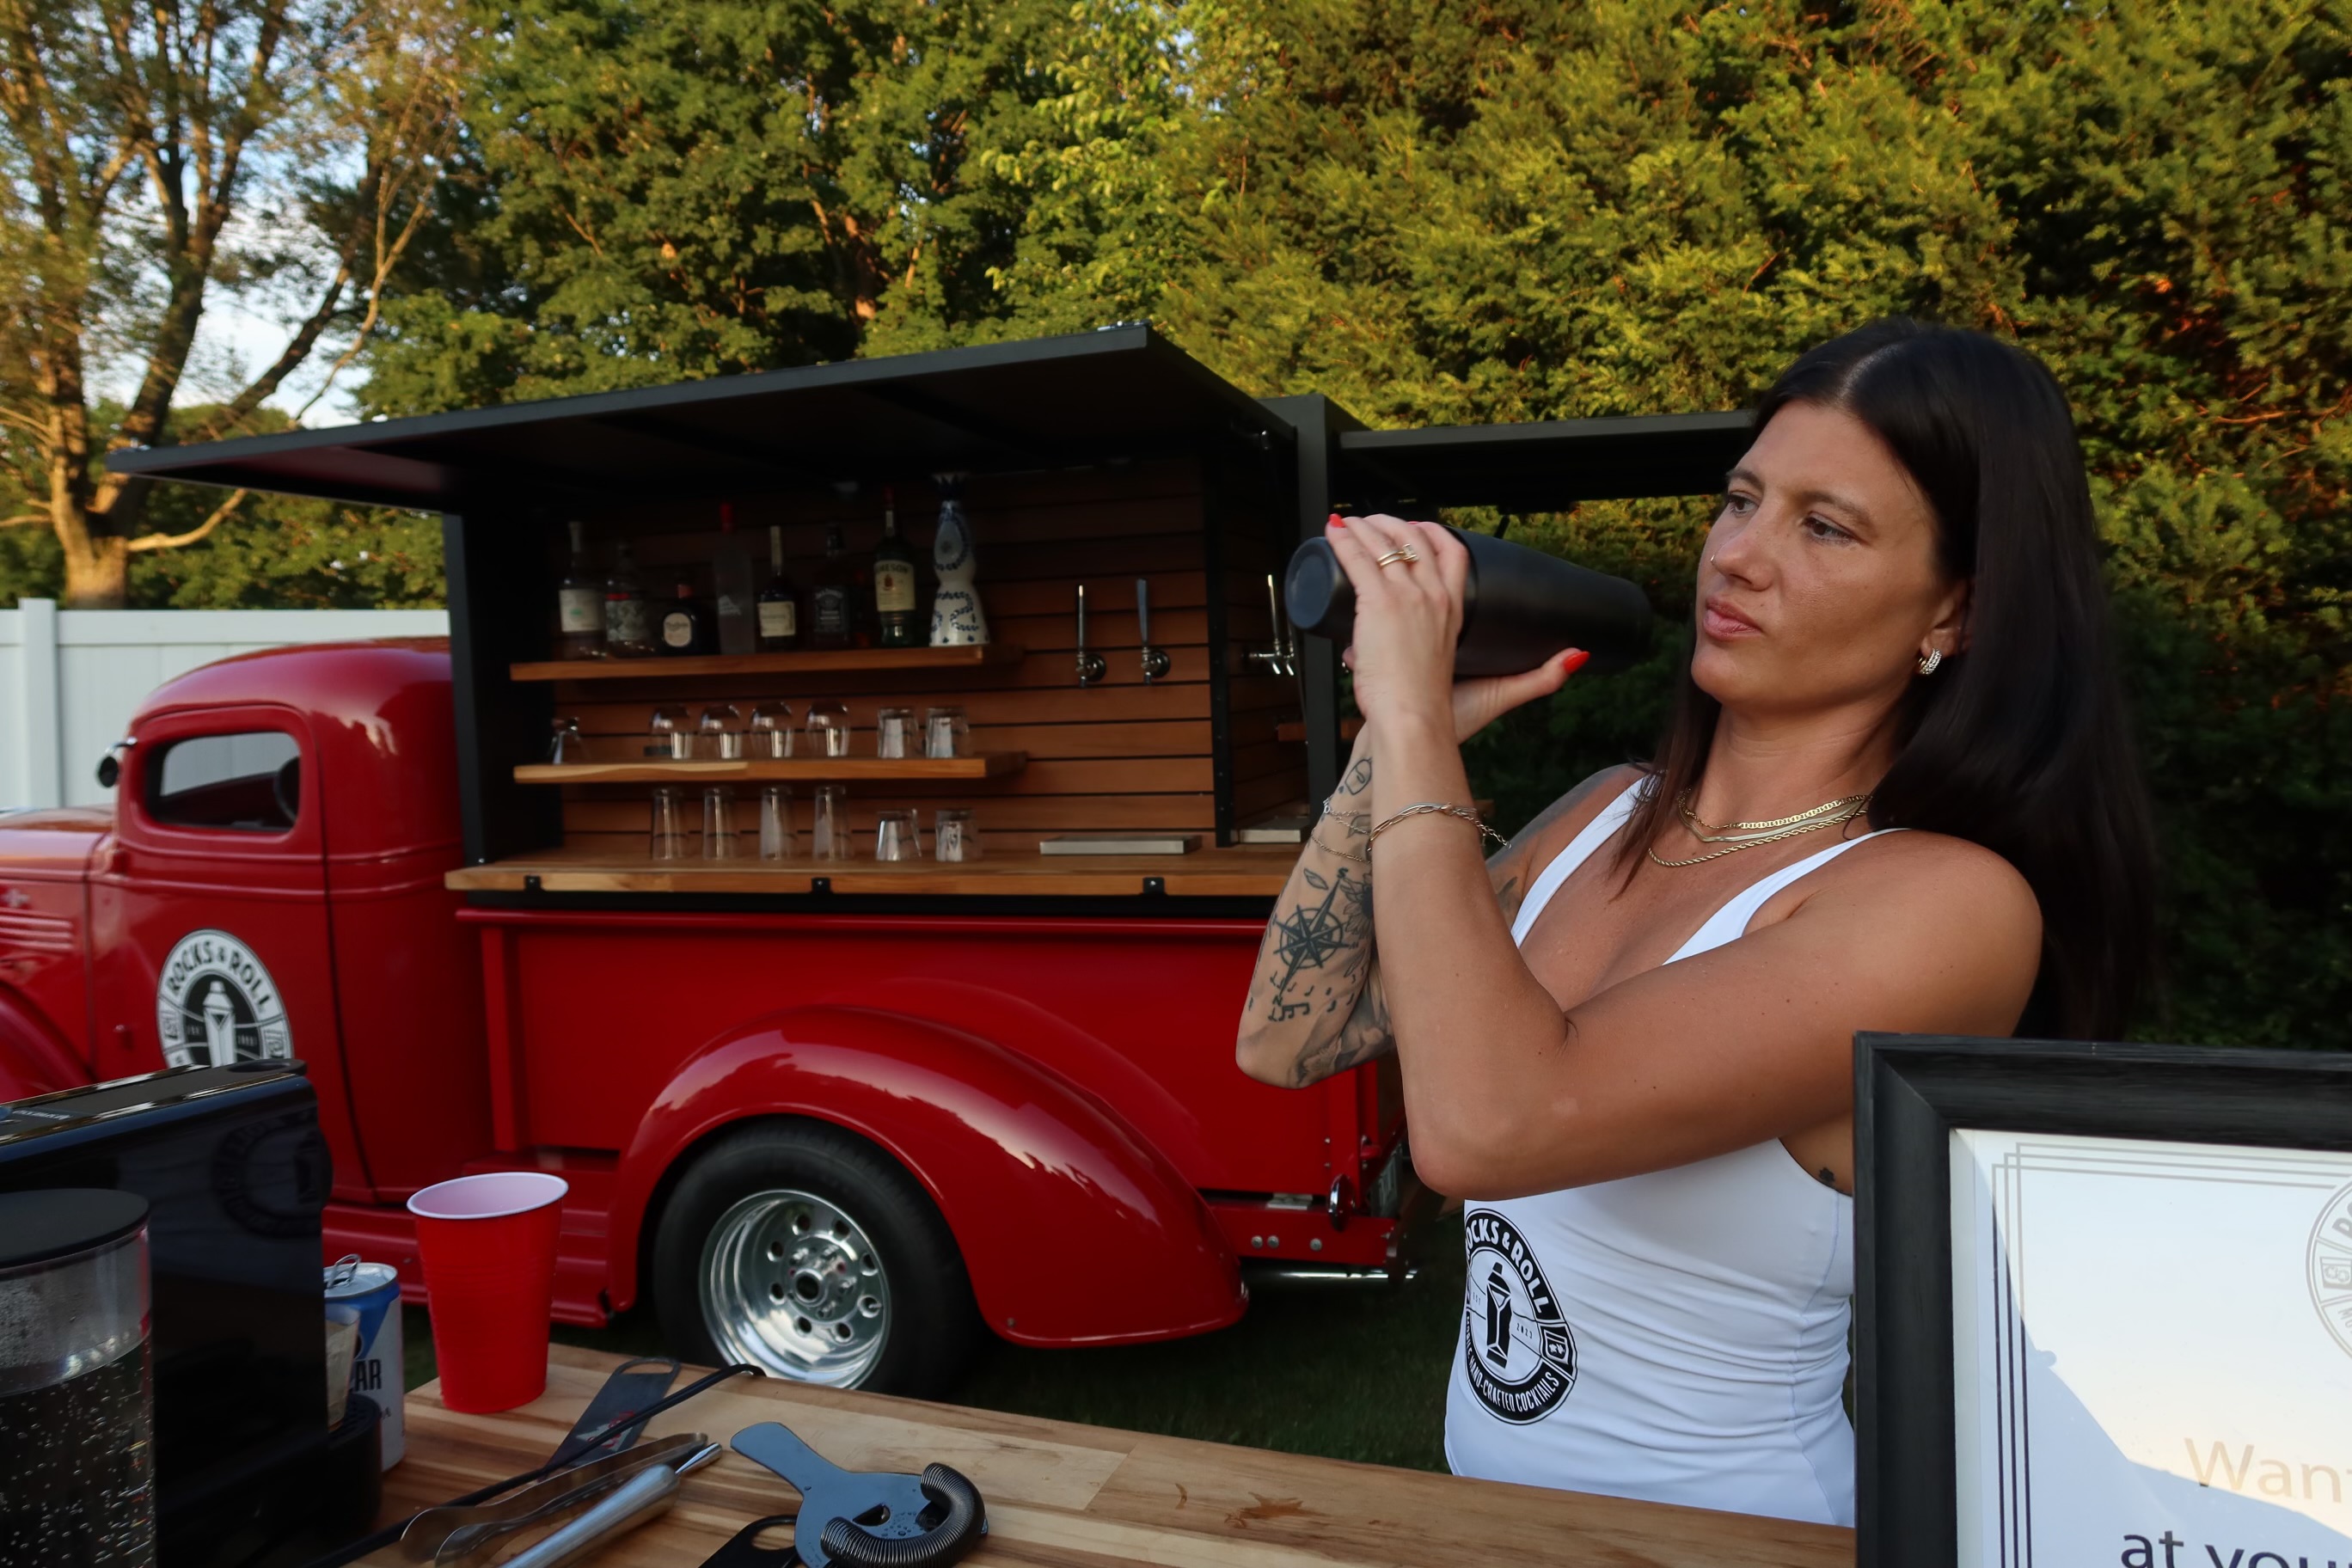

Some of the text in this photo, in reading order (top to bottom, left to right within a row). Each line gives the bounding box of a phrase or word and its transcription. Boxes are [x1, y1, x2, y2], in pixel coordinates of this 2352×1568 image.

[167, 940, 271, 1013] ROCKS & ROLL
[1502, 1232, 1511, 1251] &
[1510, 1240, 1550, 1314] ROLL
[1516, 1322, 1533, 1339] 2023
[1468, 1354, 1516, 1412] HAND-CRAFTED
[1515, 1371, 1560, 1412] COCKTAILS
[2184, 1437, 2352, 1504] Wan
[2121, 1530, 2184, 1568] at
